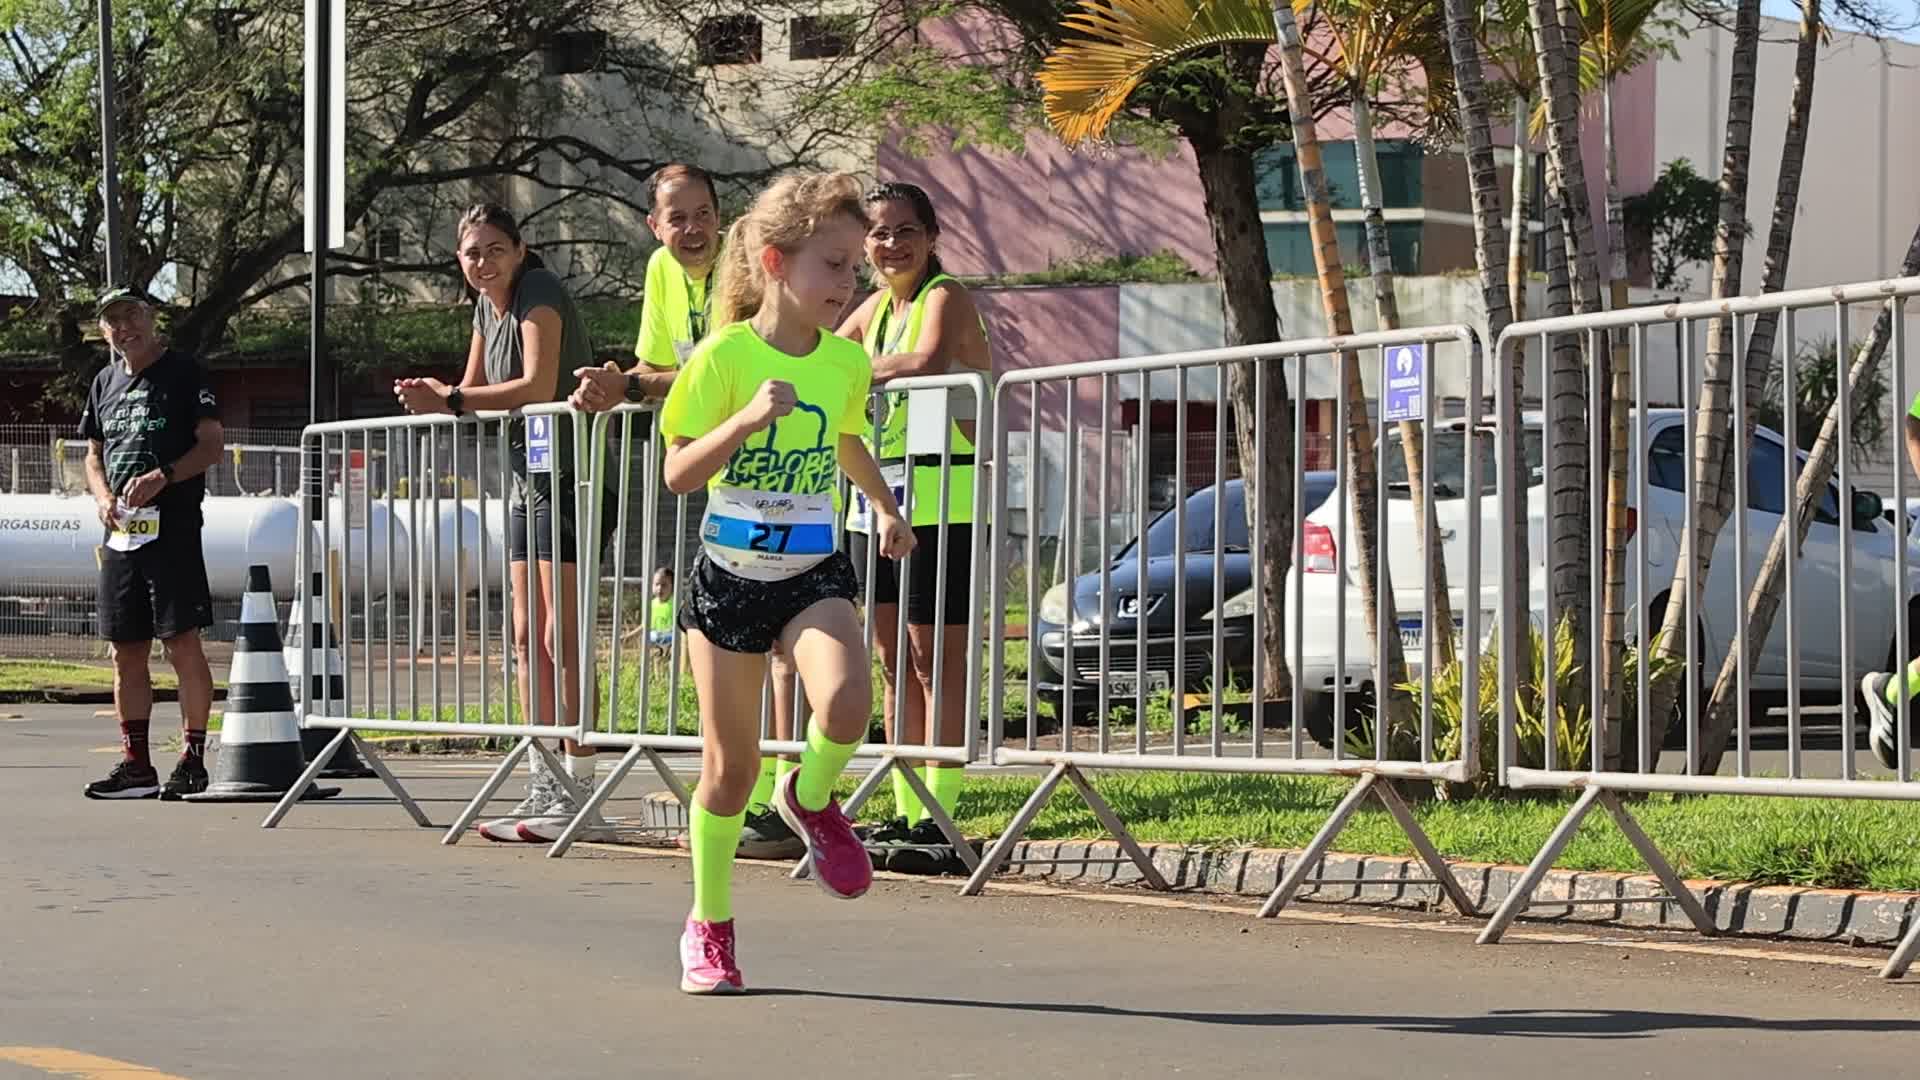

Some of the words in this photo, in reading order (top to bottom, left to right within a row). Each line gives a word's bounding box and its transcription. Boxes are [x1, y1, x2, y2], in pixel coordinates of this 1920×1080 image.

[0, 519, 80, 531] RGASBRAS
[750, 523, 792, 553] 27
[757, 553, 783, 561] MARIA
